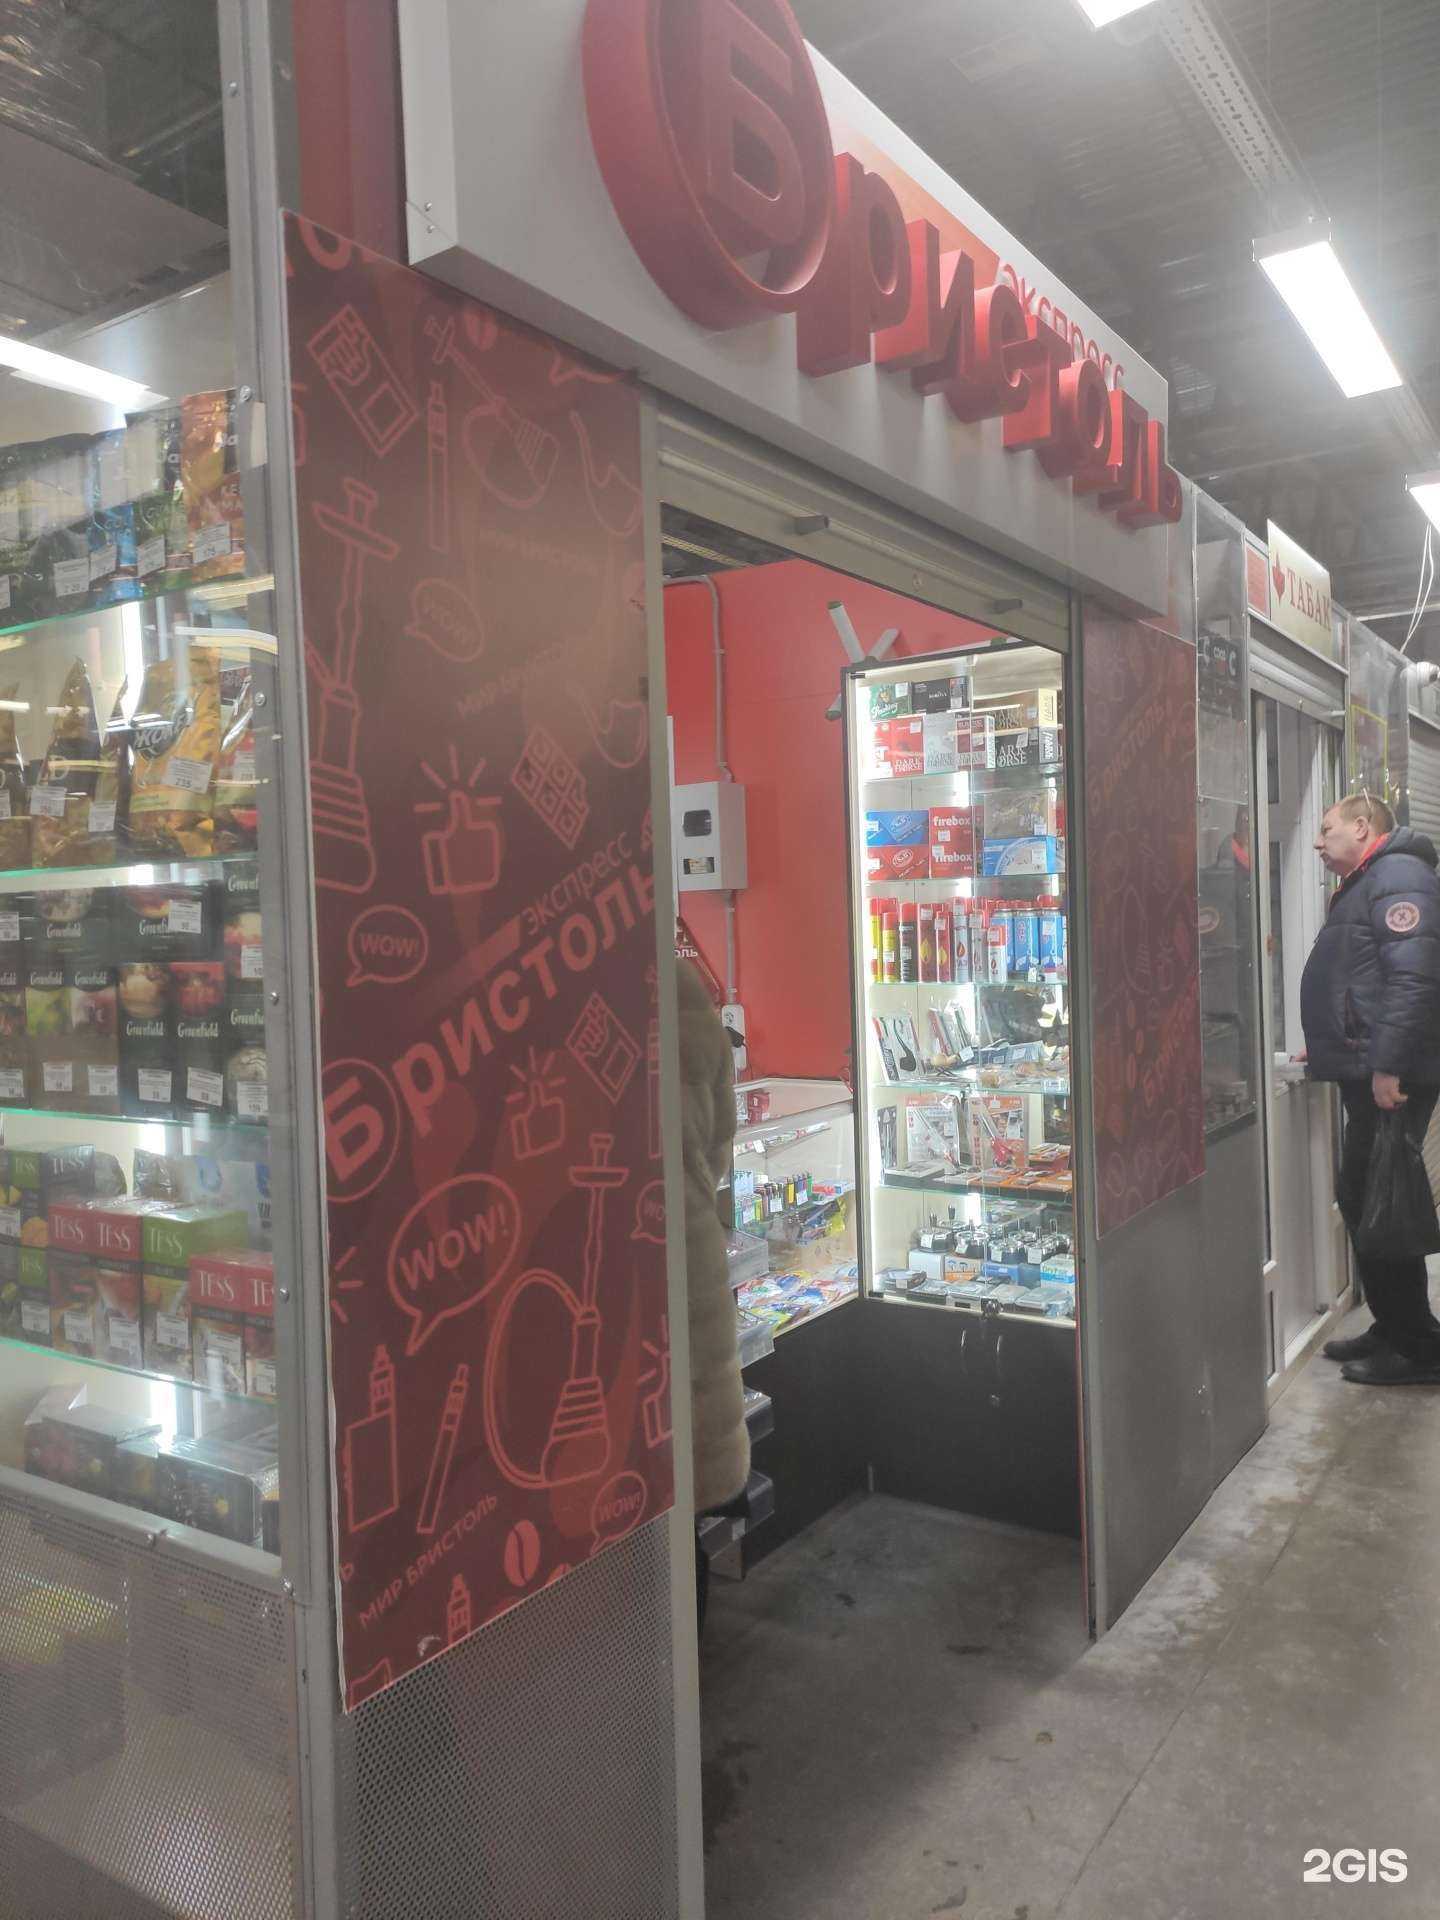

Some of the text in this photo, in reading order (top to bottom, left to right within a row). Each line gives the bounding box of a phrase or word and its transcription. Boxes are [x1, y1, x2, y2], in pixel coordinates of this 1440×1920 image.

[1286, 566, 1332, 632] ТАБАК
[933, 815, 971, 828] firebox
[522, 831, 635, 936] экспресс
[357, 931, 420, 959] WOW!
[126, 1020, 164, 1037] Greenfield
[177, 1021, 219, 1039] Greenfield
[53, 1214, 84, 1244] TESS
[97, 1221, 132, 1252] TESS
[150, 1227, 183, 1258] TESS
[399, 1203, 510, 1292] WOW!
[198, 1270, 235, 1303] TESS
[599, 1491, 641, 1521] WOW!
[359, 1494, 498, 1630] МИР БРИСТОЛЬ
